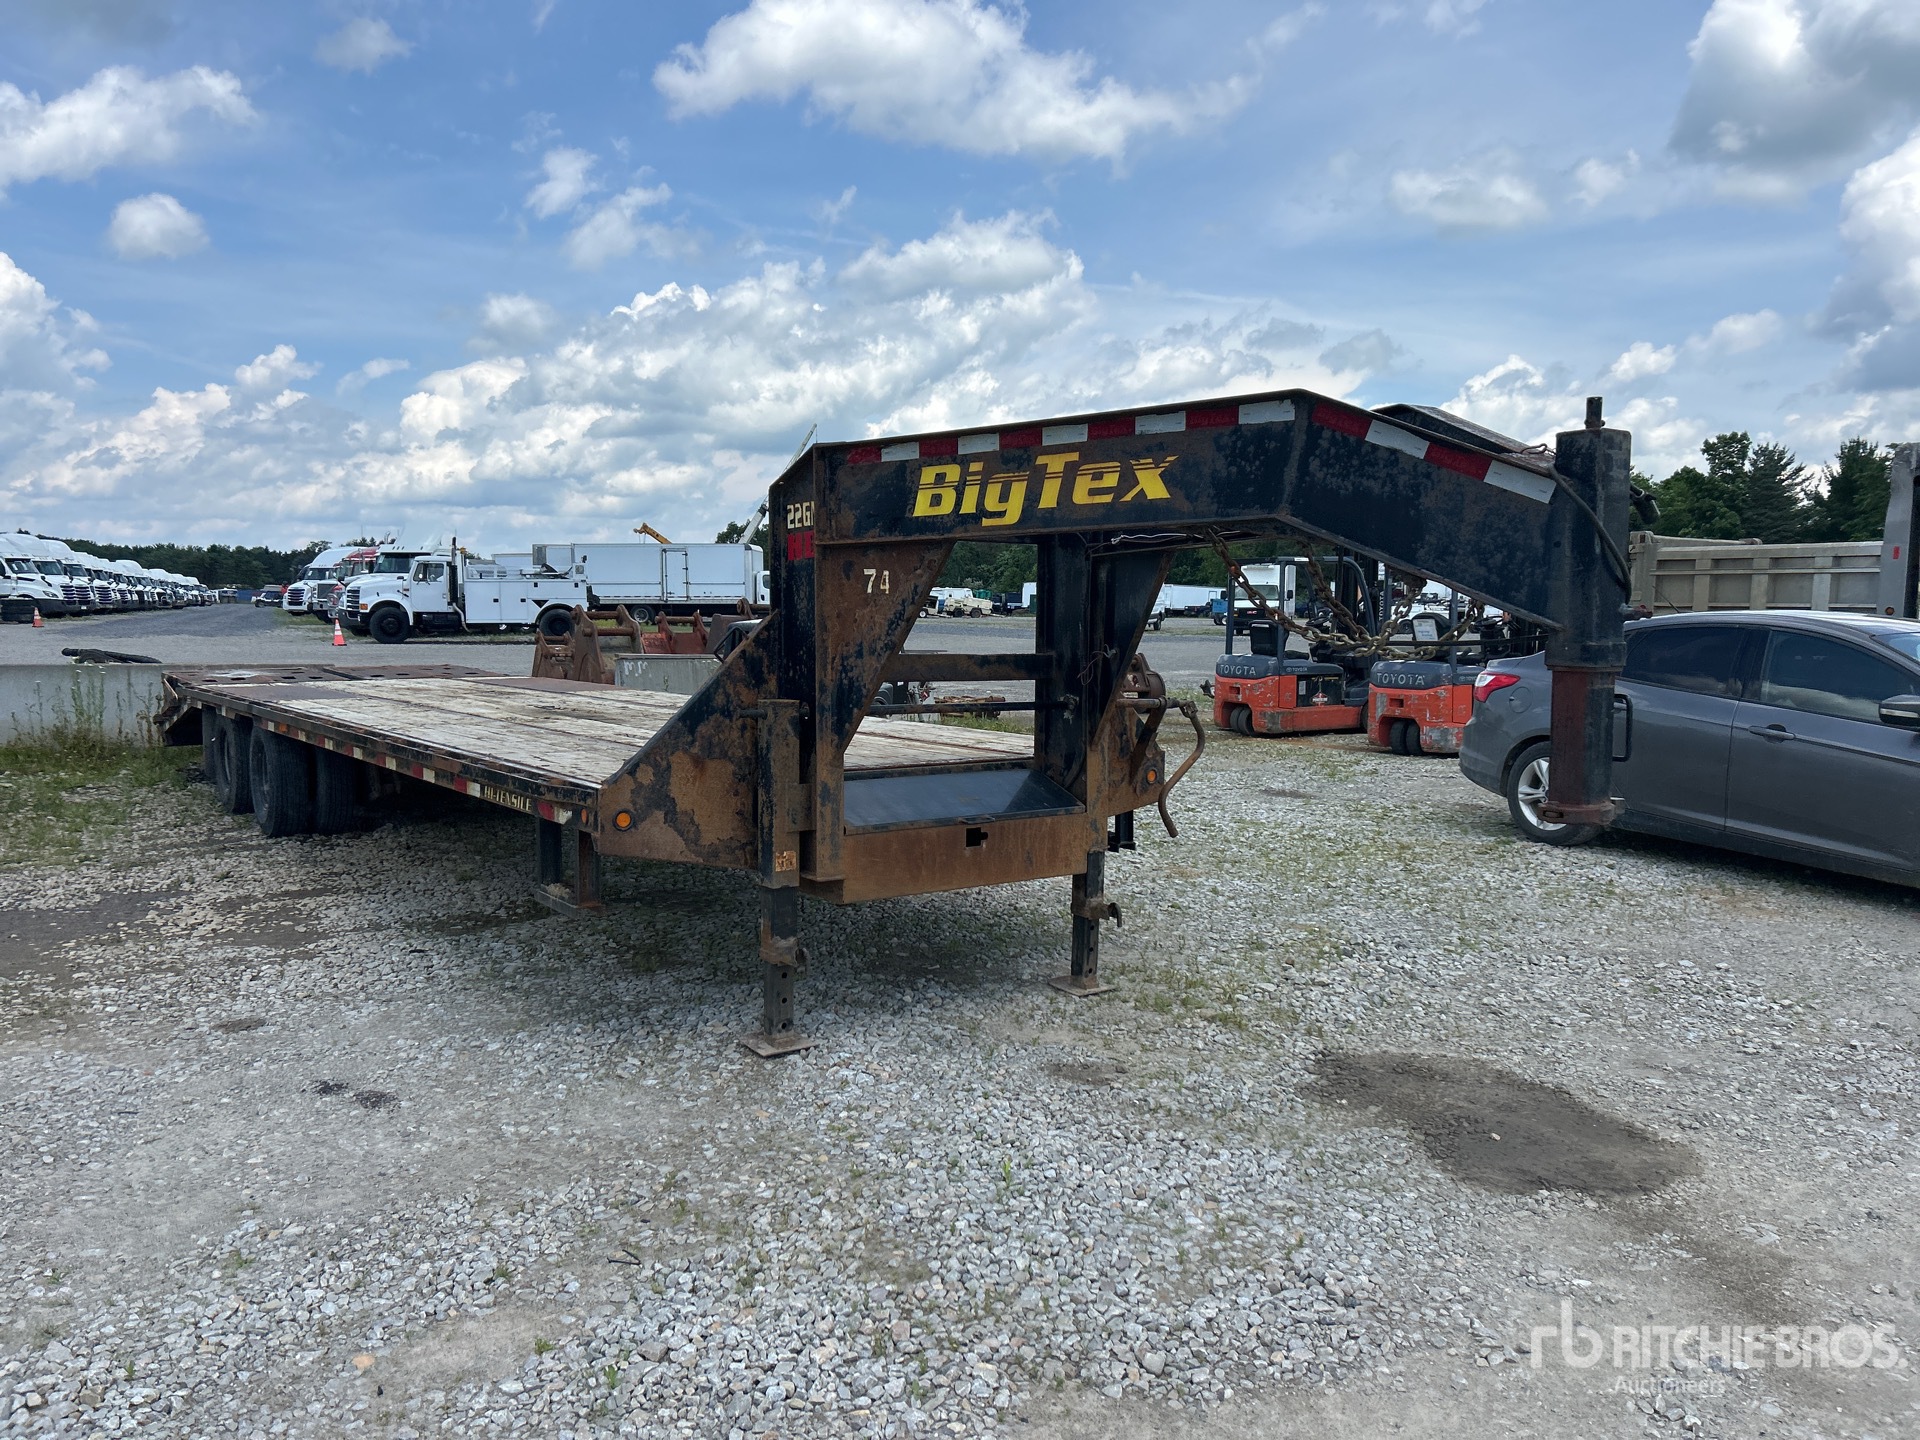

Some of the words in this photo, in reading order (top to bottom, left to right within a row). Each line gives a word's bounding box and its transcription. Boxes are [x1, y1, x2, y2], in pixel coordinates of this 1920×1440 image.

[863, 569, 890, 594] 74
[1220, 664, 1257, 676] TOYOTA
[1376, 672, 1426, 685] TOYOTA
[484, 785, 532, 811] HI-TENSILE
